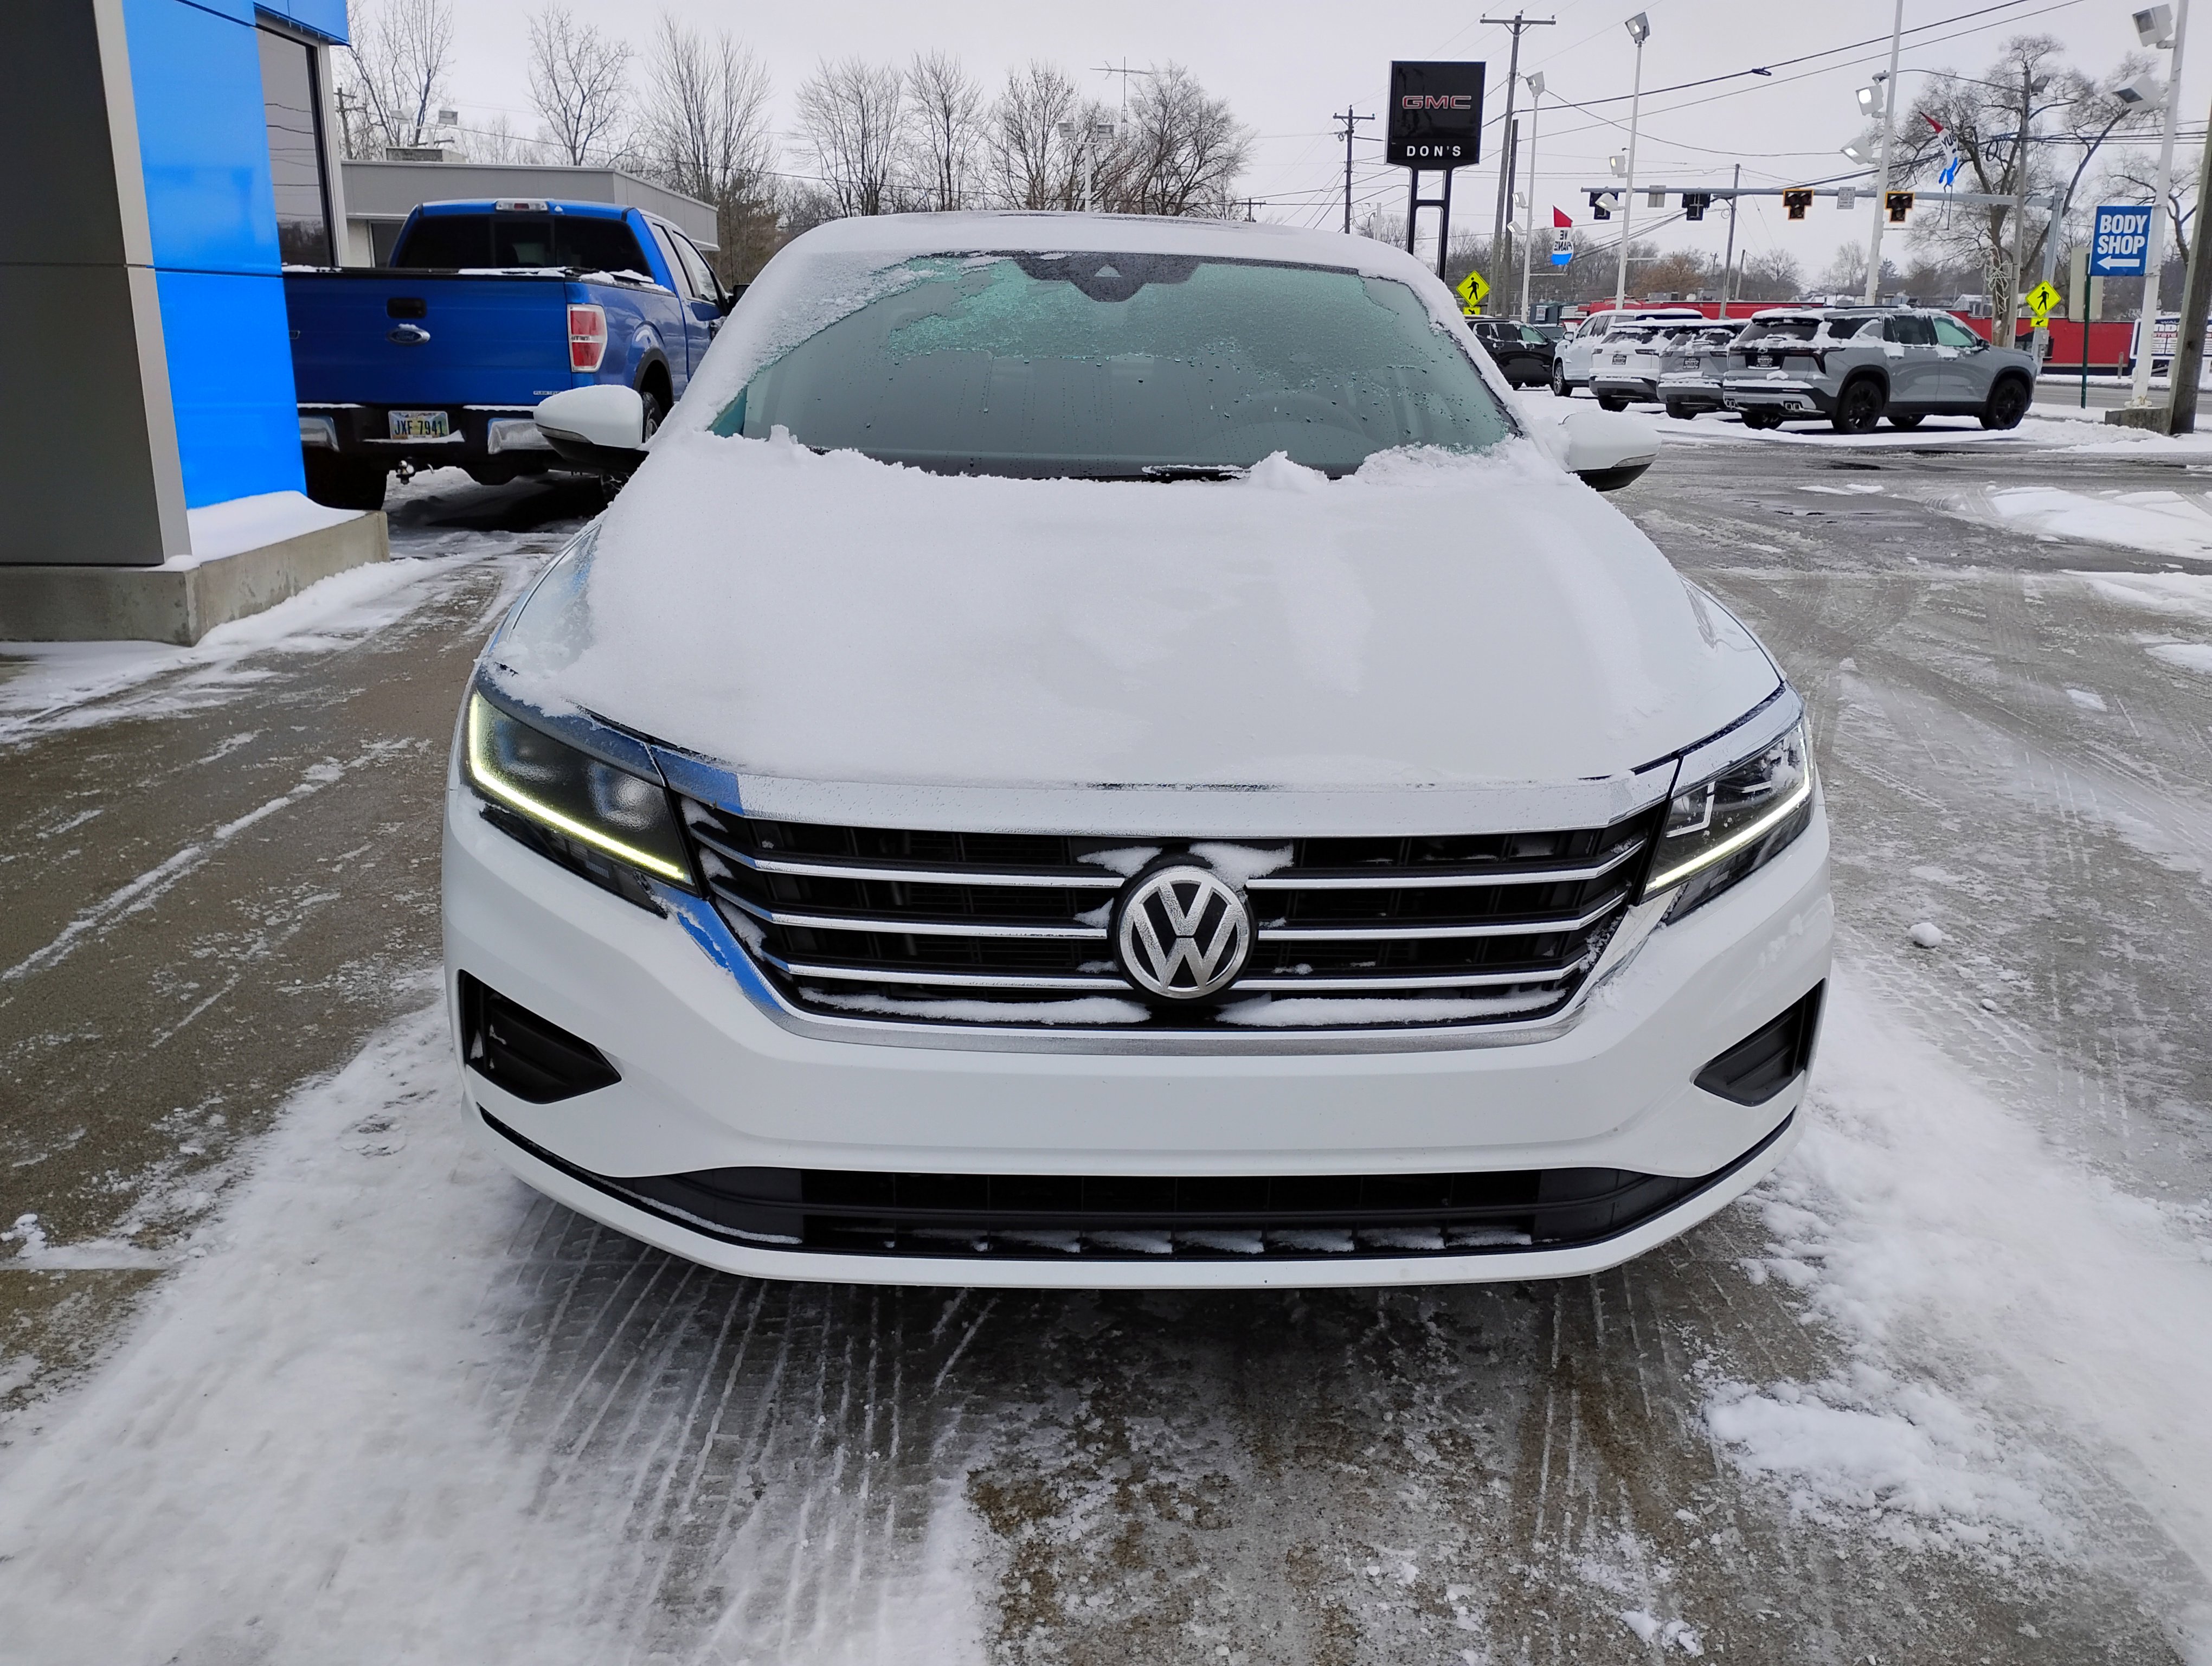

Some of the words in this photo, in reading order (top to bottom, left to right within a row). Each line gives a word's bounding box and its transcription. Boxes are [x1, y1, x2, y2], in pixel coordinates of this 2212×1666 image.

[1402, 95, 1472, 110] GMC
[1406, 145, 1462, 157] DON'S
[2099, 214, 2149, 234] BODY
[2097, 235, 2146, 255] SHOP
[394, 420, 413, 435] JXF
[417, 420, 443, 436] 7941
[1124, 874, 1244, 994] VW
